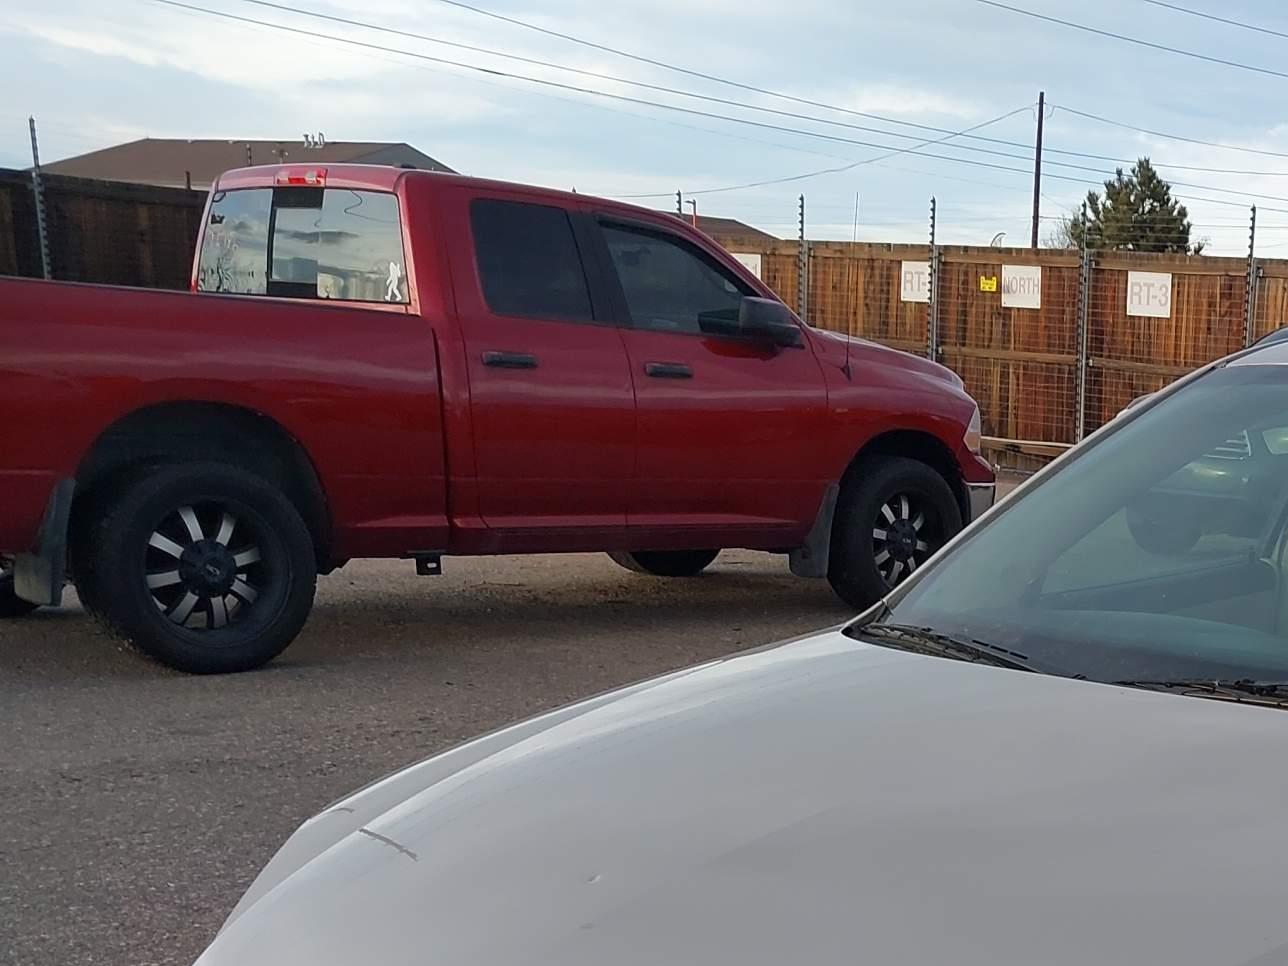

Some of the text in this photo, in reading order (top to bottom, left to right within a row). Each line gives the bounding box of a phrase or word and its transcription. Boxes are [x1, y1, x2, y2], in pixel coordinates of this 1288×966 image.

[904, 270, 928, 292] RT-
[1003, 276, 1040, 295] NORTH
[1130, 281, 1169, 307] RT-3
